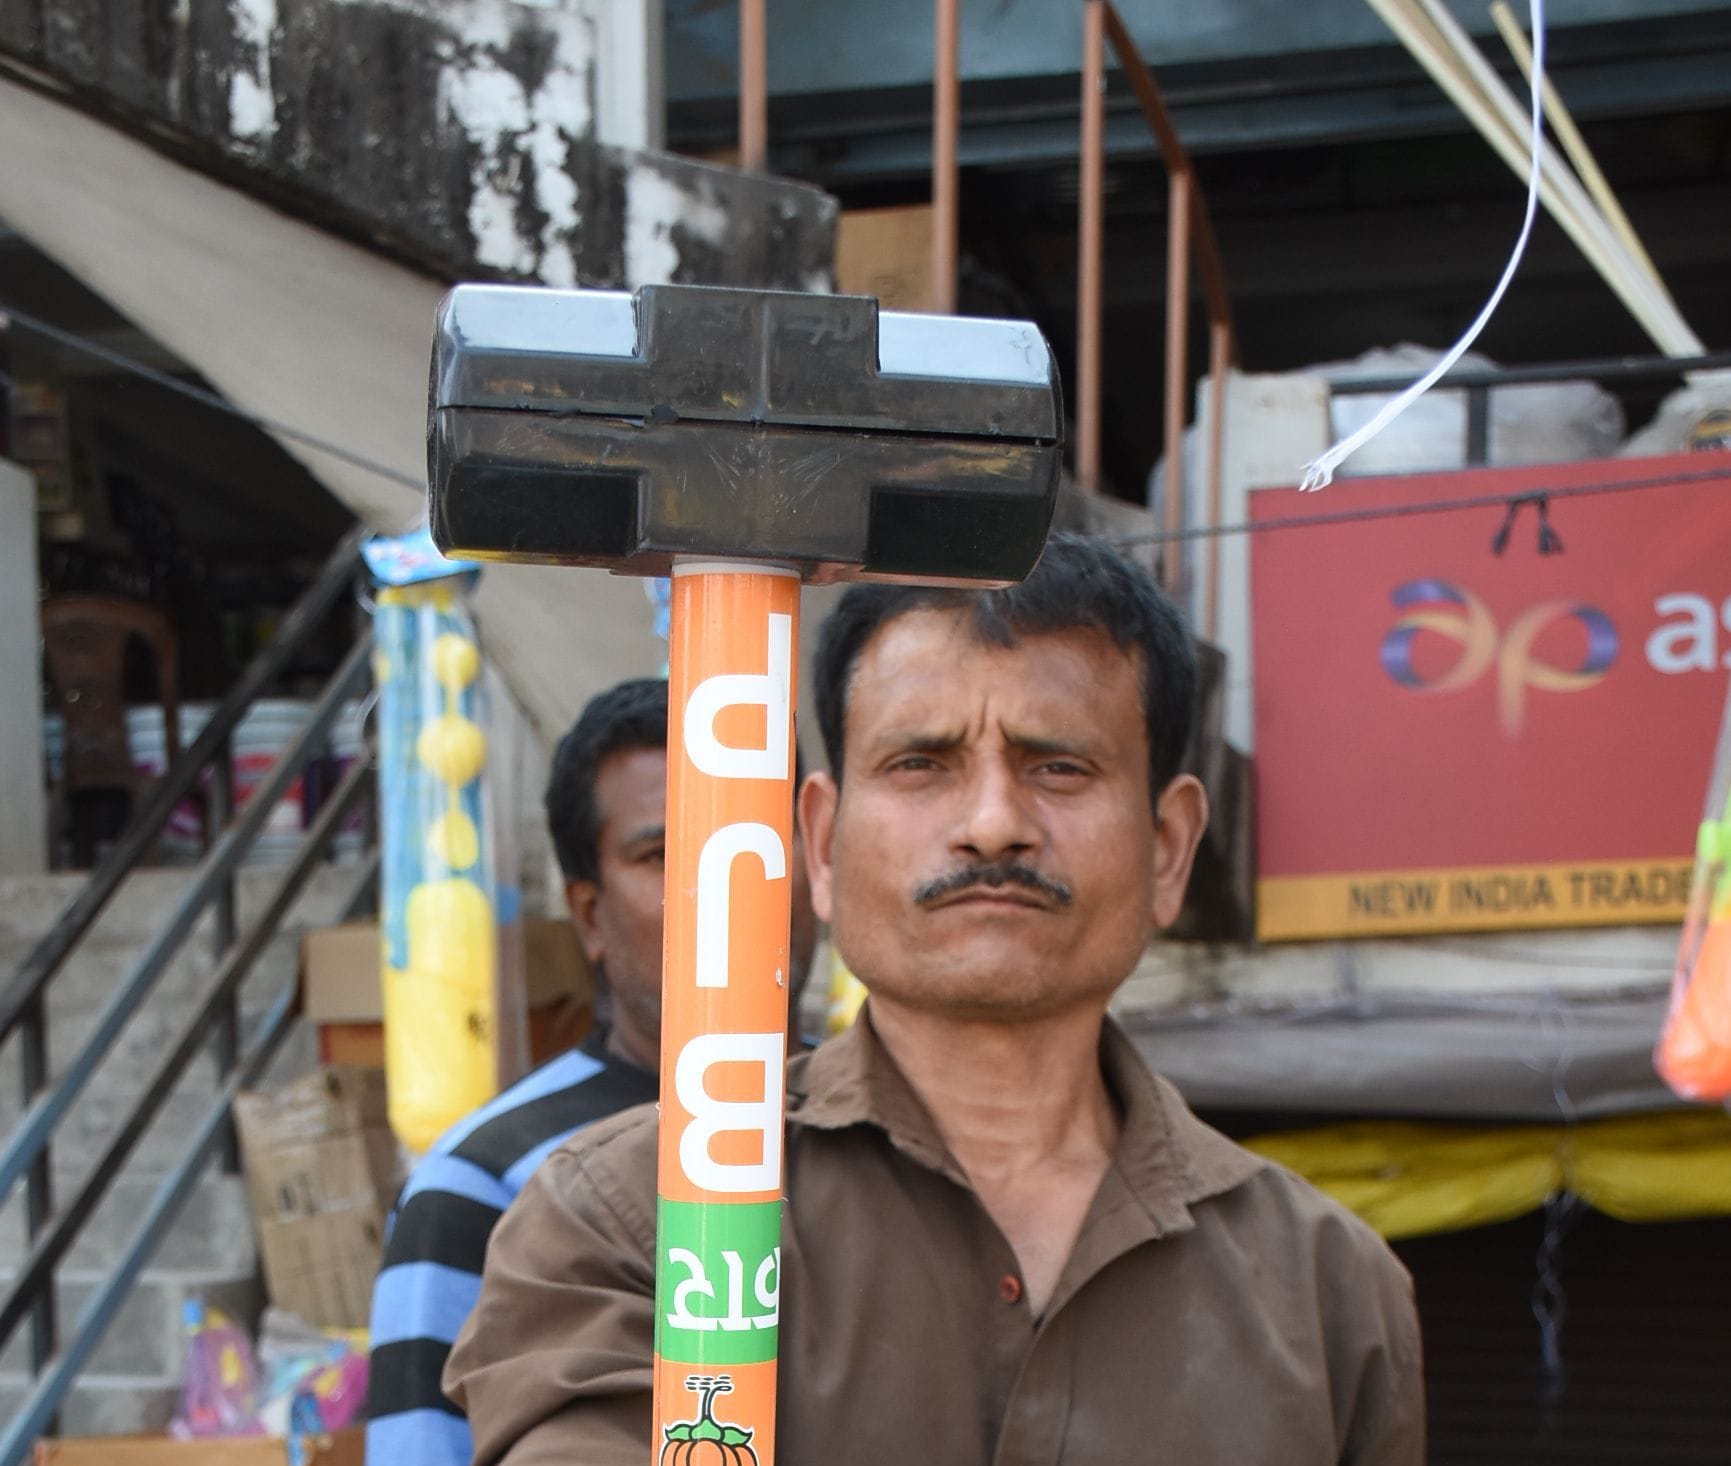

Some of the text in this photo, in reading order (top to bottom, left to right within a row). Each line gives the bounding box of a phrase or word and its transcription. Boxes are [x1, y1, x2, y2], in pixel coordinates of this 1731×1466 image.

[1645, 592, 1731, 674] a
[675, 613, 792, 1192] BJP
[1348, 878, 1440, 918] NEW
[1447, 873, 1554, 914] INDIA
